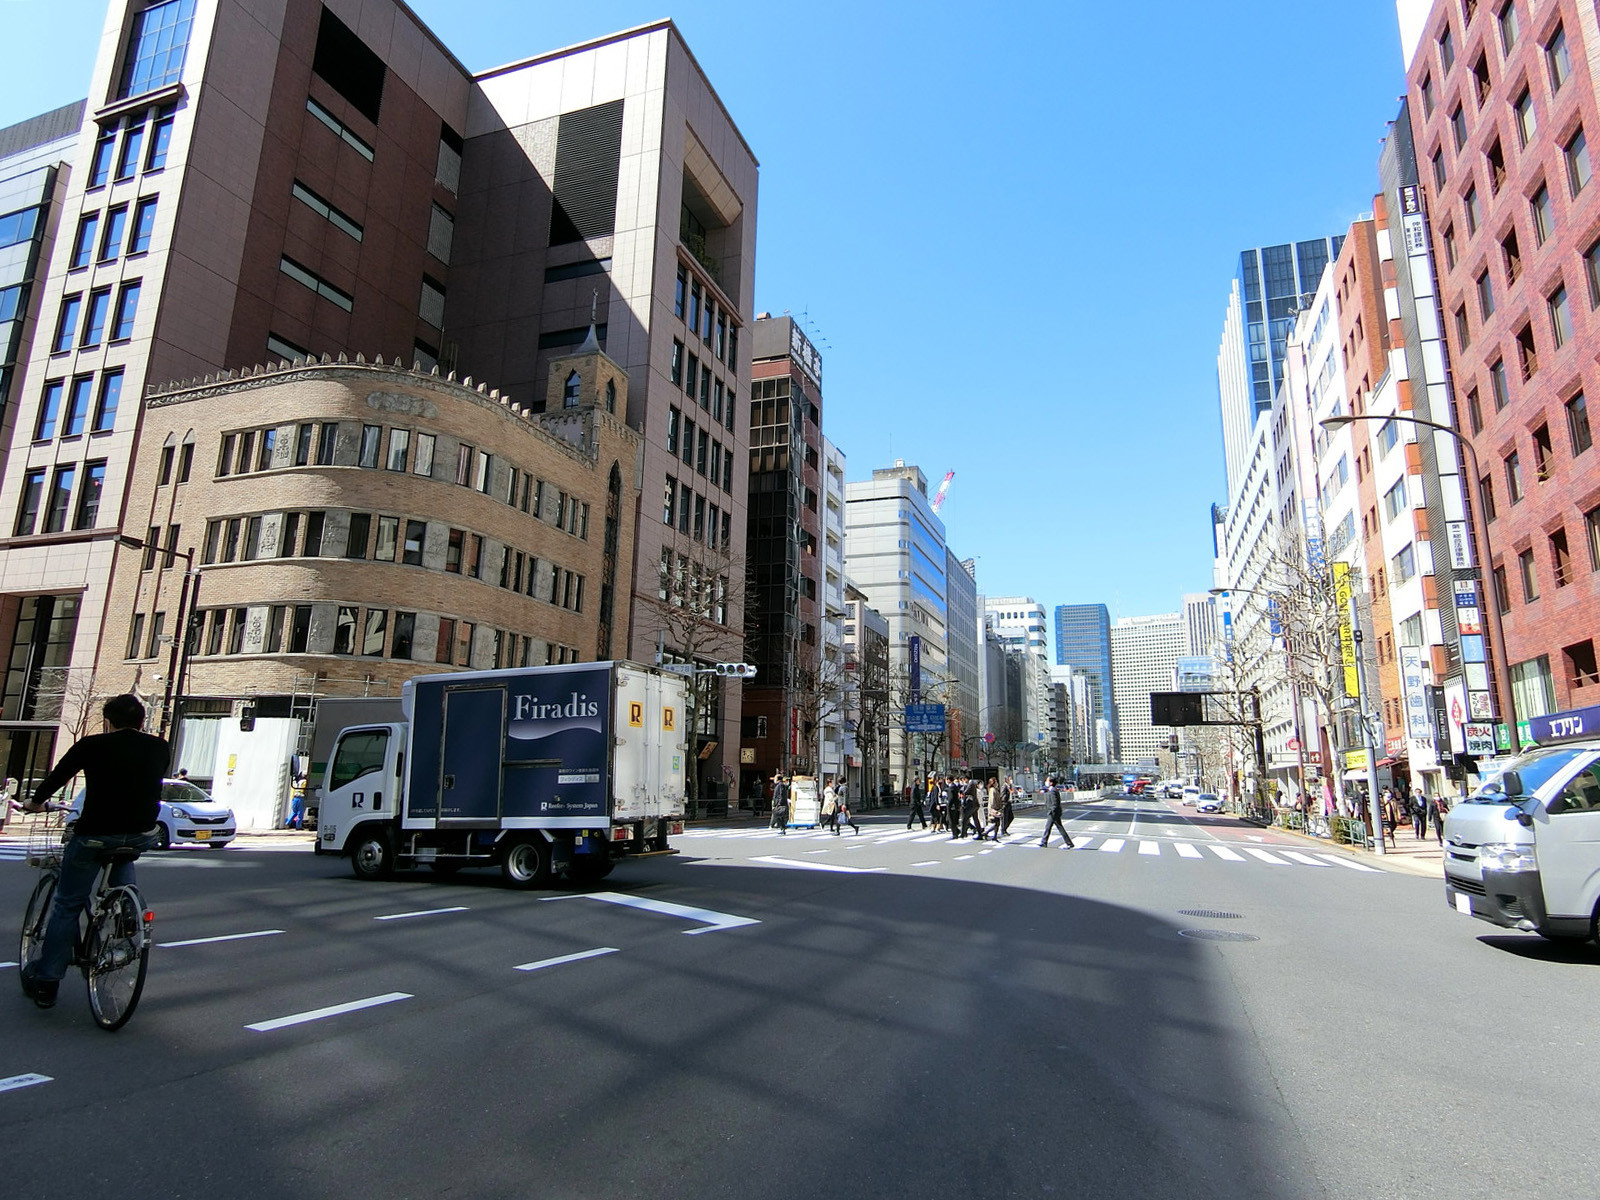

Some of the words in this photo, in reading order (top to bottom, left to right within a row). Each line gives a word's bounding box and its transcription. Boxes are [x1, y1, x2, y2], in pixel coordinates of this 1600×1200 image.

[1339, 590, 1348, 613] GOF
[1405, 656, 1426, 727] 天野歯科
[513, 692, 598, 720] Firadis
[1466, 726, 1491, 737] 炭火
[1469, 740, 1493, 751] 焼肉
[566, 802, 583, 810] System
[584, 802, 598, 810] Japan
